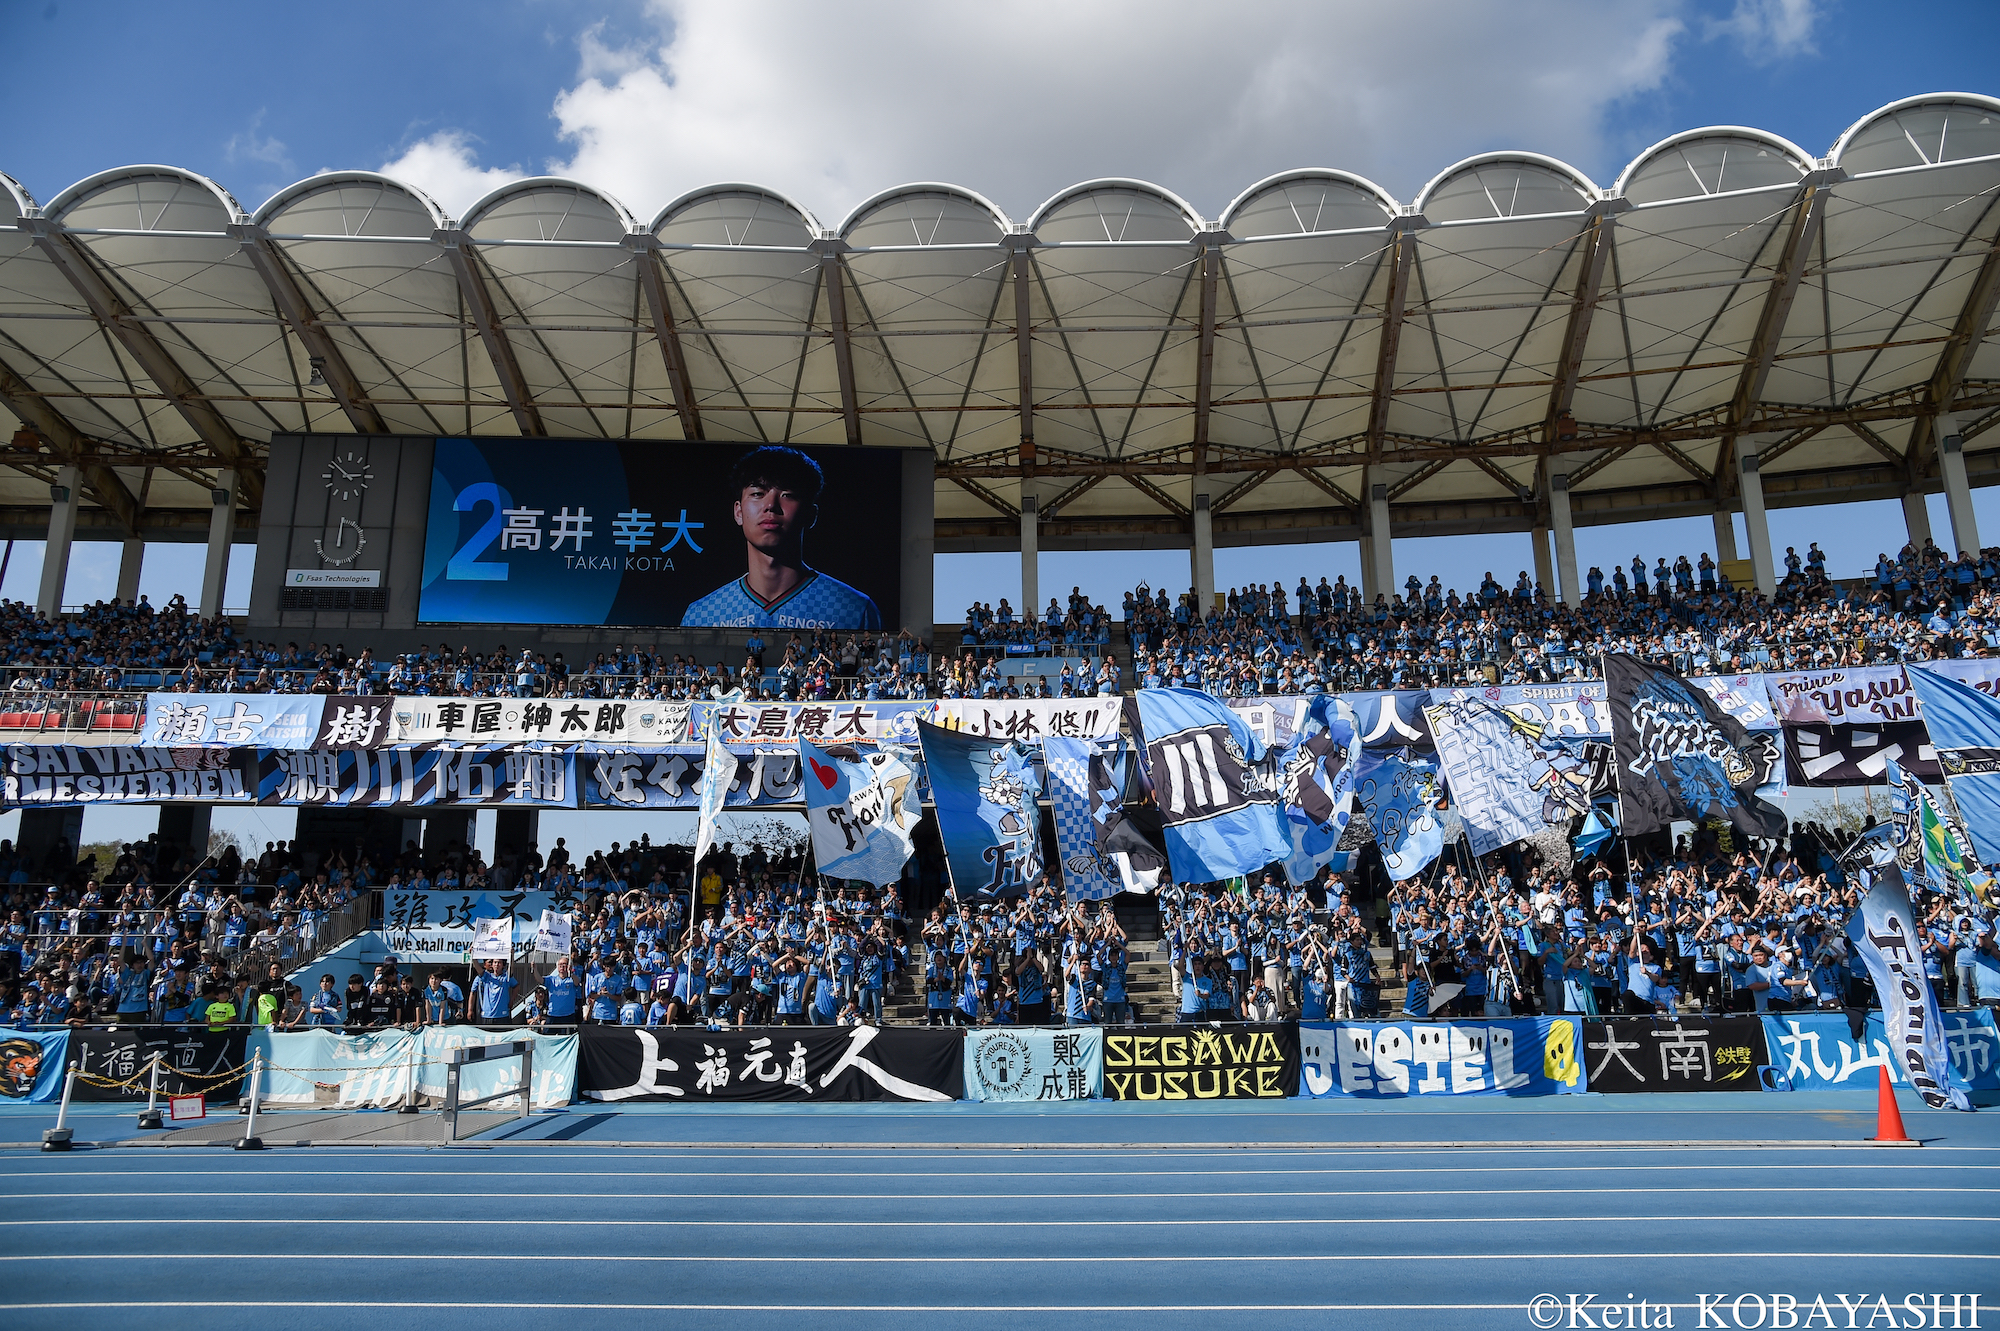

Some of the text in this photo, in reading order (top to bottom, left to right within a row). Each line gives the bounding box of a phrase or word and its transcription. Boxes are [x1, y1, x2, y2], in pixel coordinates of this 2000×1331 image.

[446, 482, 514, 581] 2
[501, 506, 704, 554] 高井 幸大
[564, 555, 675, 571] TAKAI KOTA
[325, 575, 371, 583] Technologies
[778, 614, 836, 629] RENOSY
[1521, 686, 1602, 699] SPIRIT OF
[1778, 672, 1845, 698] Prince
[153, 701, 382, 746] 瀬古 樹
[261, 726, 313, 739] TATSUKI
[274, 713, 307, 726] SEKO
[971, 709, 1040, 741] 小林
[89, 746, 178, 774] VAN
[392, 937, 412, 951] We
[415, 938, 444, 951] shall
[1106, 1029, 1284, 1067] SEGAWA
[1300, 1025, 1531, 1096] JESIEL
[1587, 1023, 1712, 1083] 大南
[1714, 1046, 1753, 1066] 鉄壁
[582, 1025, 954, 1101] 上福元直人
[1105, 1066, 1284, 1100] YUSUKE
